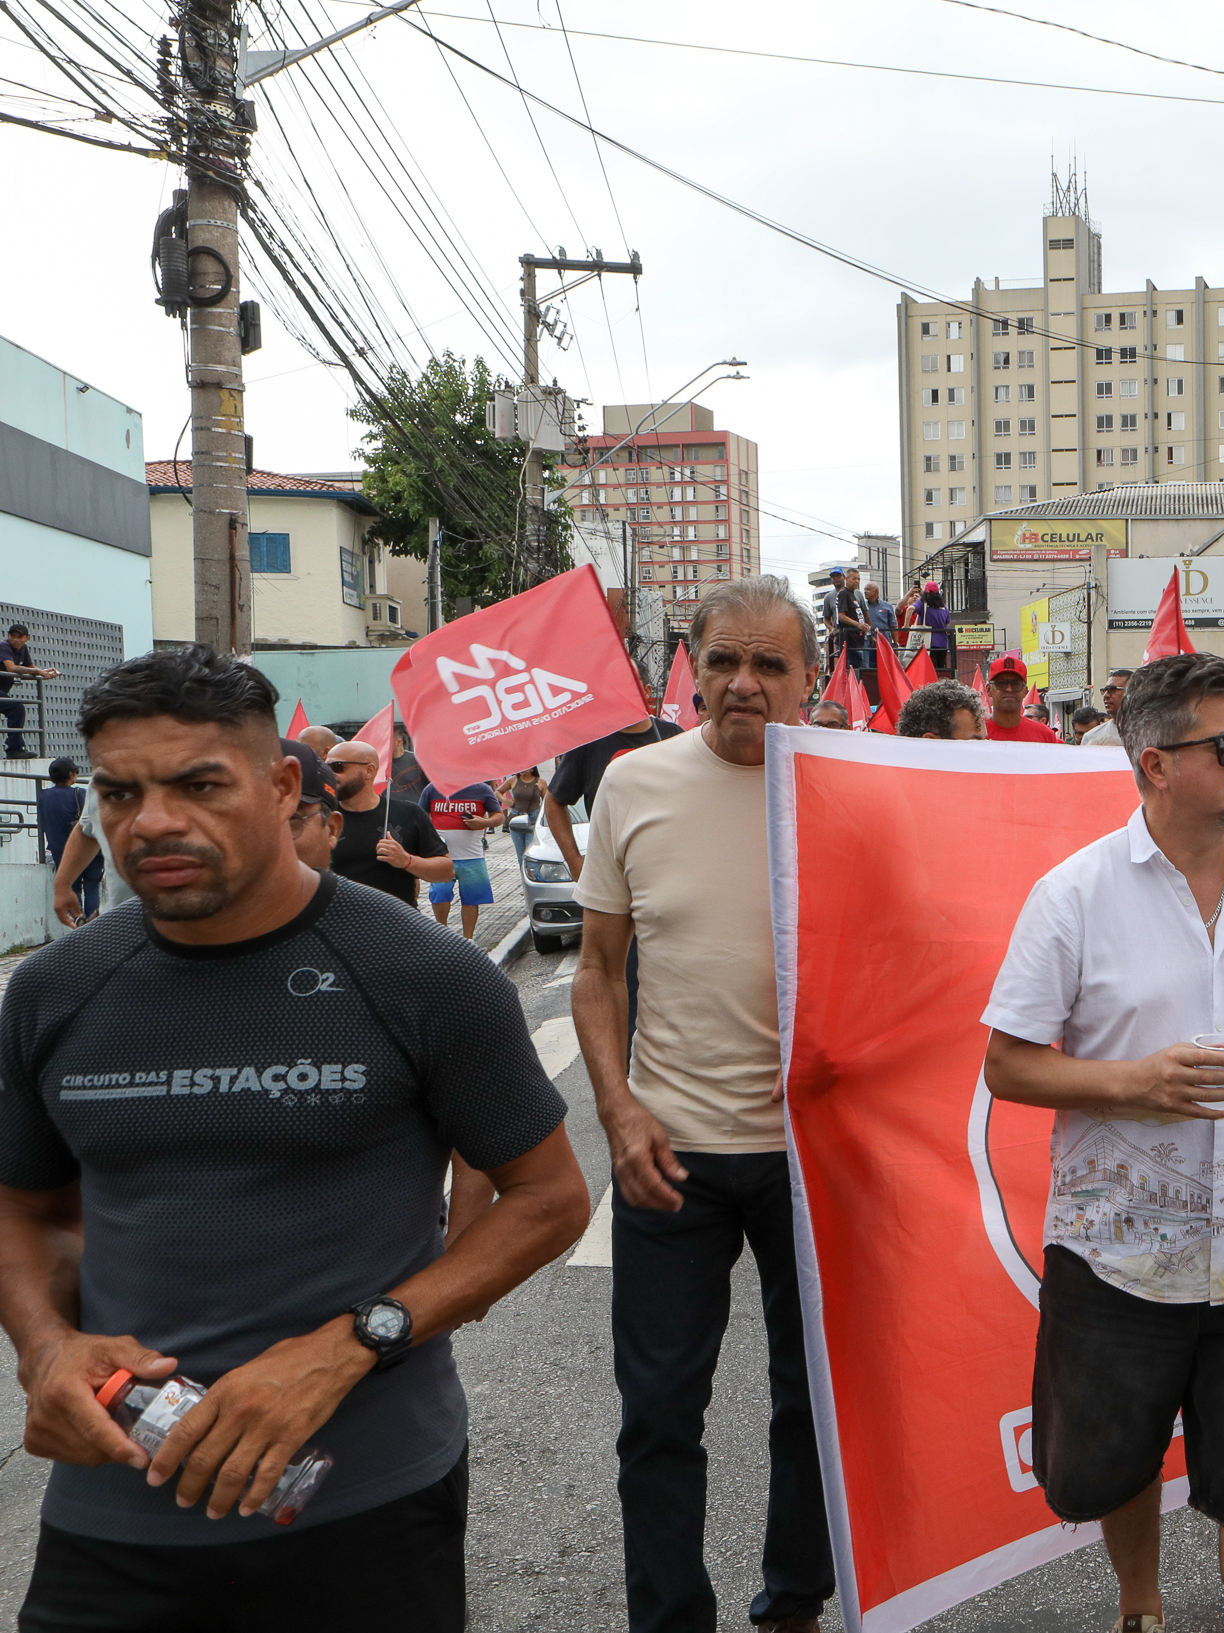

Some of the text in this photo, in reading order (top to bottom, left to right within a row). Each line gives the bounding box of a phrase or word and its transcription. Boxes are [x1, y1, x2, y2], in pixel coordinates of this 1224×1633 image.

[434, 802, 477, 813] HILFIGER
[62, 1072, 131, 1087] CIRCUITO
[135, 1070, 168, 1084] DAS
[171, 1058, 367, 1099] ESTAÇÕES
